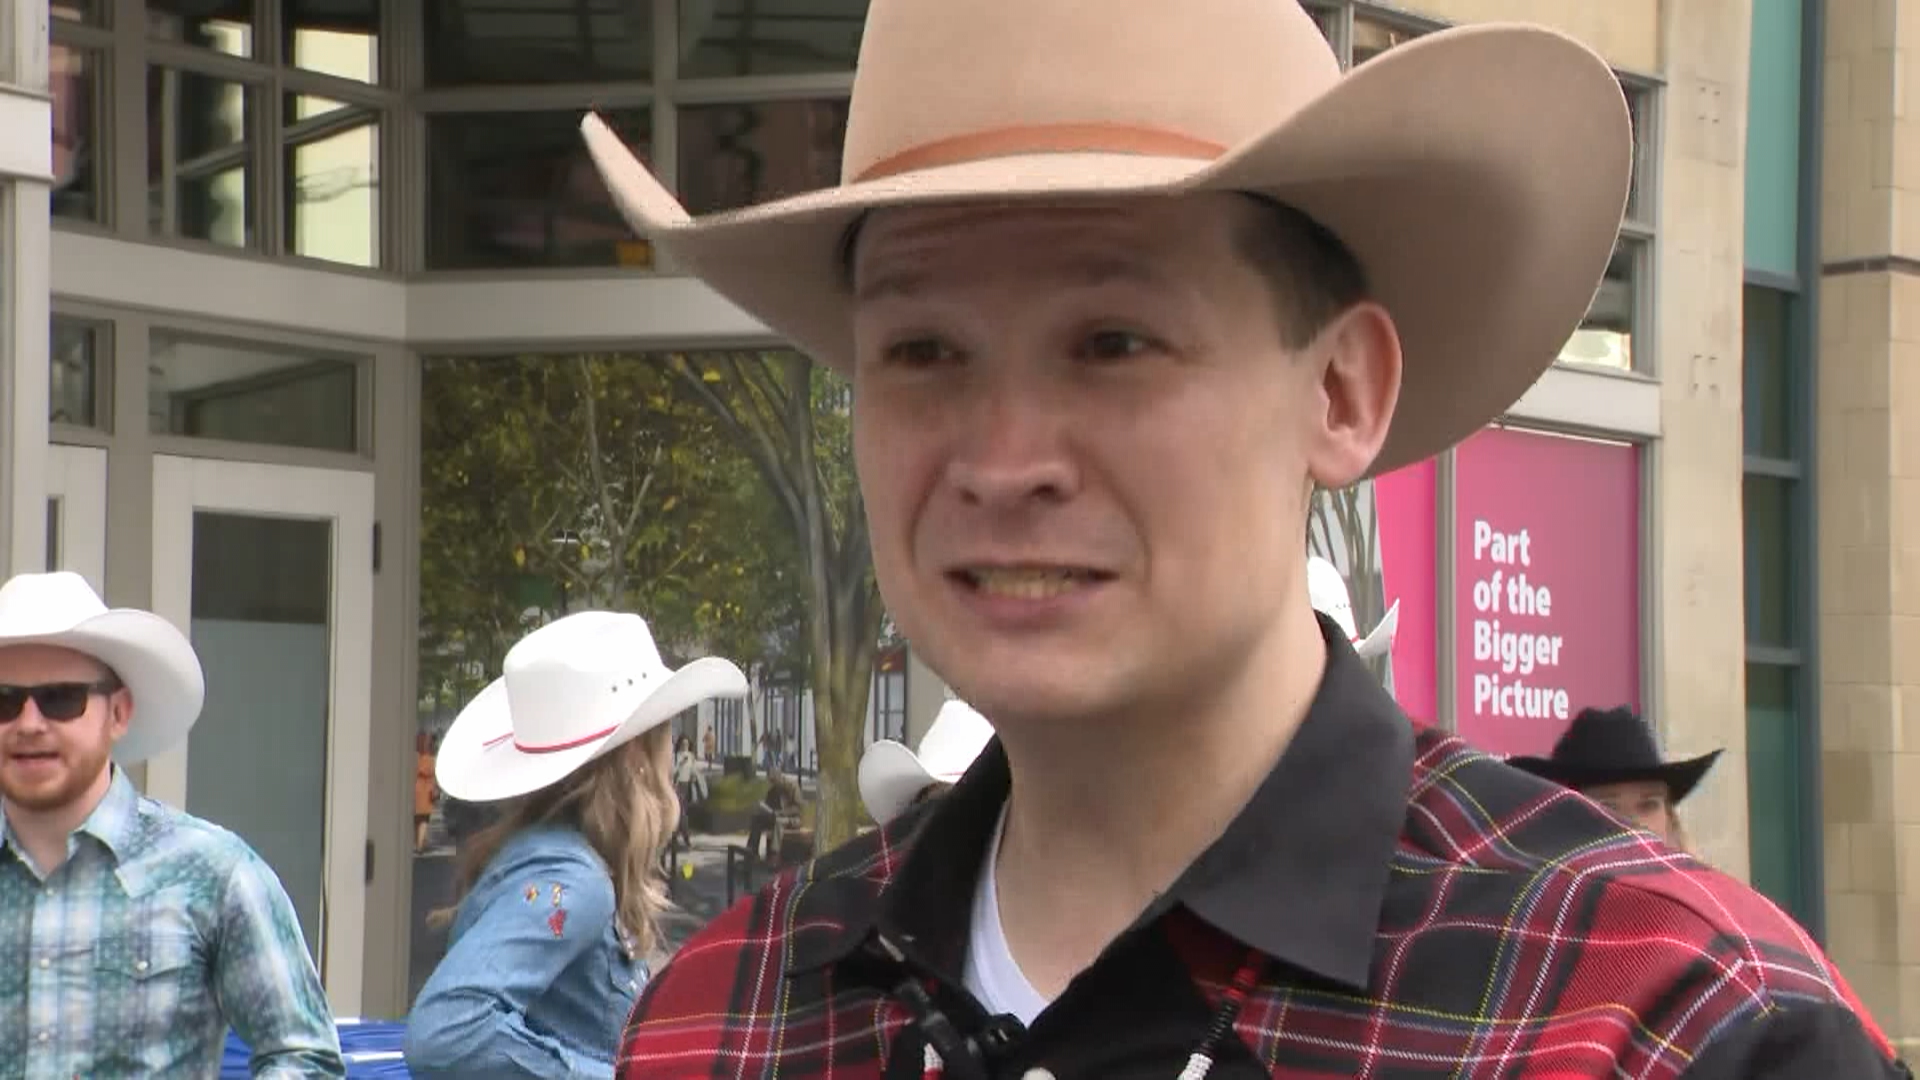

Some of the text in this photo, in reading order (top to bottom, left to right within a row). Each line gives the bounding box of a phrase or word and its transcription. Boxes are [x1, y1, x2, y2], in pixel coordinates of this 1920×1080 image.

[1474, 520, 1531, 566] Part
[1473, 570, 1551, 616] of the
[1474, 619, 1563, 675] Bigger
[1474, 673, 1569, 720] Picture
